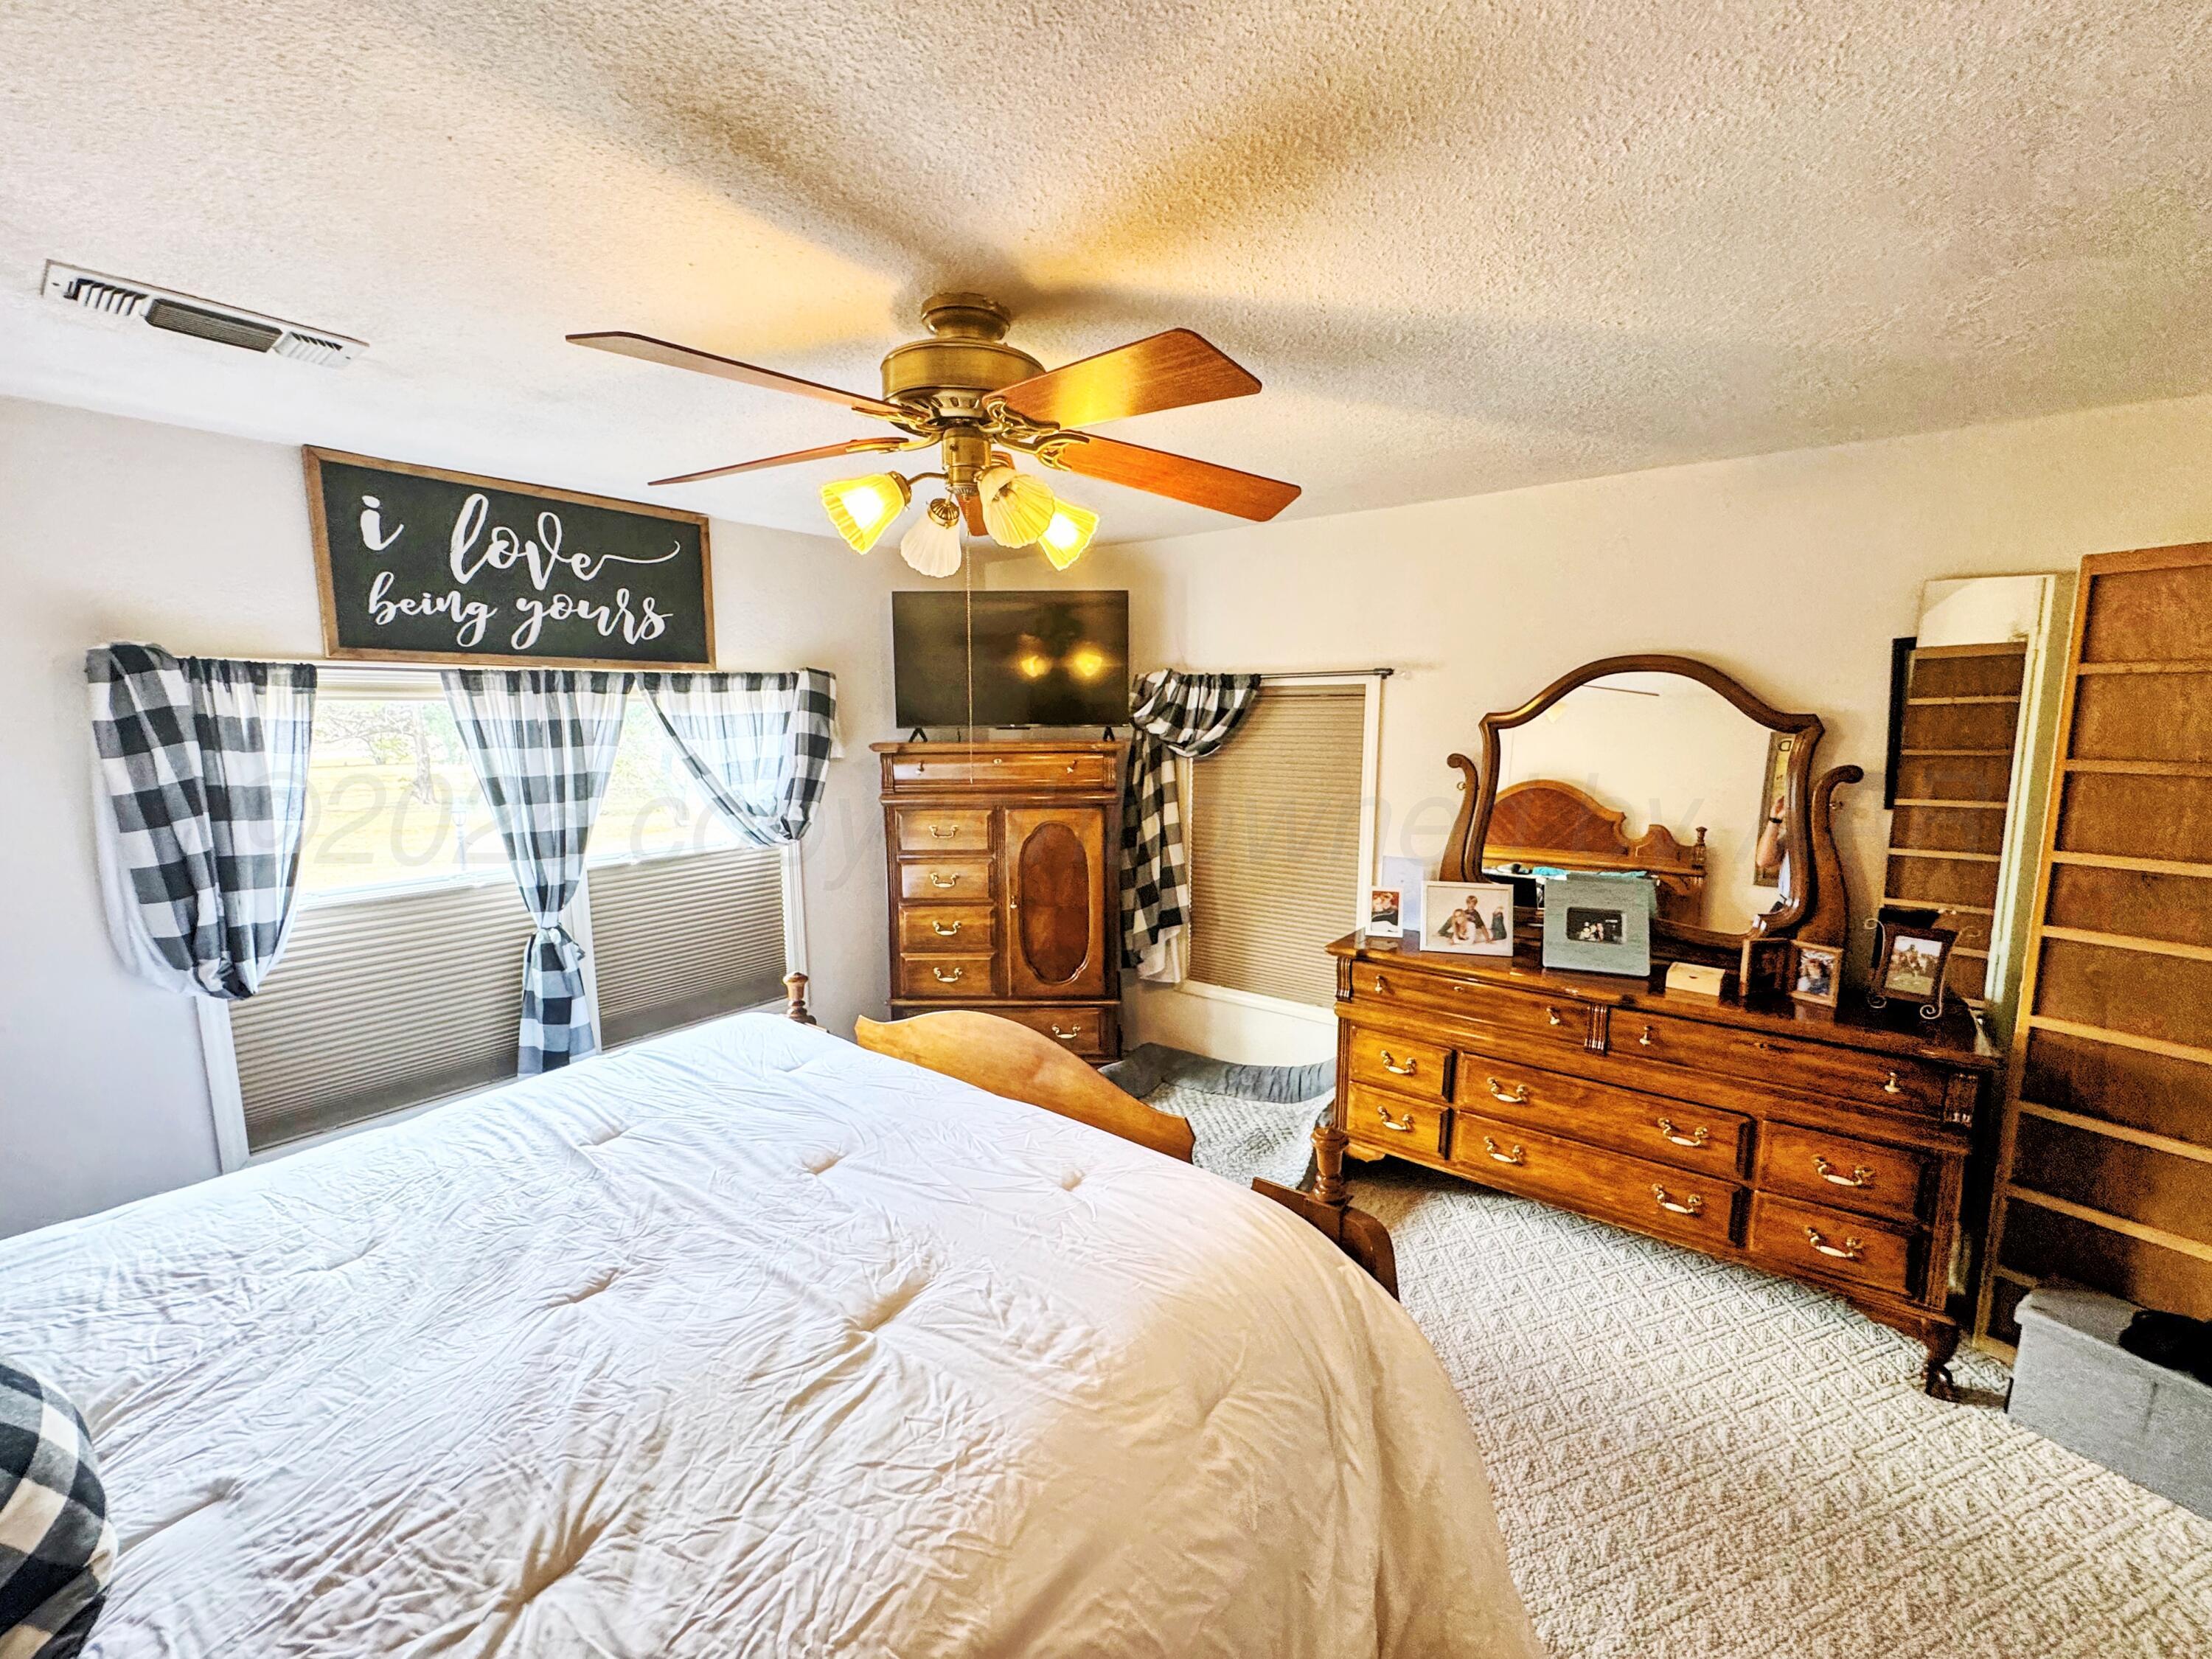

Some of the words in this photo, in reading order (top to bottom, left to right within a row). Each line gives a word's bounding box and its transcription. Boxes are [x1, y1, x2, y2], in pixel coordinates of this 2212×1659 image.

[361, 495, 404, 551] i
[450, 493, 681, 591] love
[369, 571, 498, 647] being
[511, 588, 674, 650] yours
